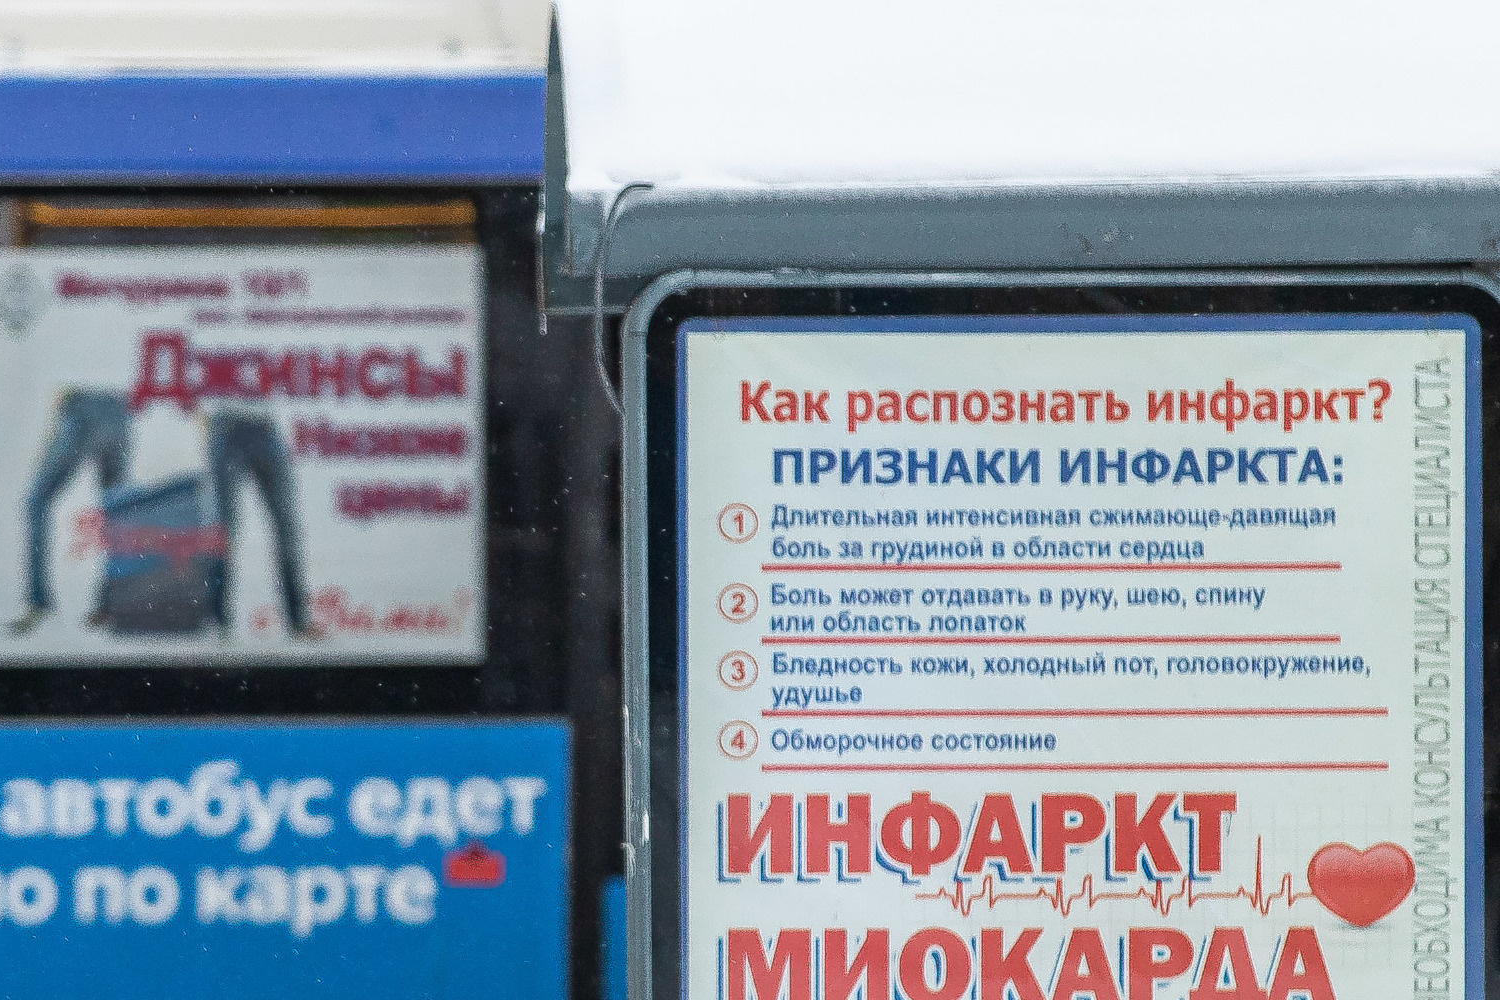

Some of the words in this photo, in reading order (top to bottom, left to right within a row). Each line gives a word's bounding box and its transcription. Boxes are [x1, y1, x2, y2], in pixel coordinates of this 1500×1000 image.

[129, 329, 466, 412] Джинсы
[741, 381, 829, 422] Как
[848, 390, 1130, 433] распознать
[1148, 379, 1391, 433] инфаркт?
[774, 449, 1040, 485] ПРИЗНАКИ
[1060, 448, 1343, 484] ИНФАРКТА:
[1414, 357, 1458, 570] СПЕЦИАЛИСТА
[771, 506, 918, 530] Длительная
[926, 510, 1081, 526] интенсивная
[1089, 508, 1336, 529] сжимающе-давящая
[772, 536, 830, 558] боль
[839, 541, 863, 558] за
[870, 537, 983, 563] грудиной
[992, 542, 1005, 557] в
[1013, 536, 1111, 558] области
[1119, 540, 1205, 563] сердца
[771, 583, 832, 605] Боль
[840, 589, 913, 605] может
[921, 589, 1030, 608] отдавать
[1040, 589, 1052, 604] в
[1061, 589, 1118, 610] руку,
[1127, 588, 1186, 608] шею,
[1195, 588, 1265, 609] спину
[771, 616, 814, 632] или
[823, 610, 921, 632] область
[929, 616, 1025, 632] лопаток
[773, 652, 902, 677] Бледность
[911, 658, 974, 677] кожи,
[984, 652, 1106, 677] холодный
[1114, 657, 1158, 676] пот,
[1167, 656, 1370, 678] головокружение,
[772, 686, 862, 708] удушье
[1414, 576, 1458, 807] КОНСУЛЬТАЦИЯ
[771, 729, 923, 753] Обморочное
[931, 734, 1056, 750] состояние
[0, 759, 335, 852] автобус
[349, 775, 546, 848] едет
[716, 790, 1238, 884] ИНФАРКТ
[73, 865, 180, 925] по
[196, 865, 438, 938] карте
